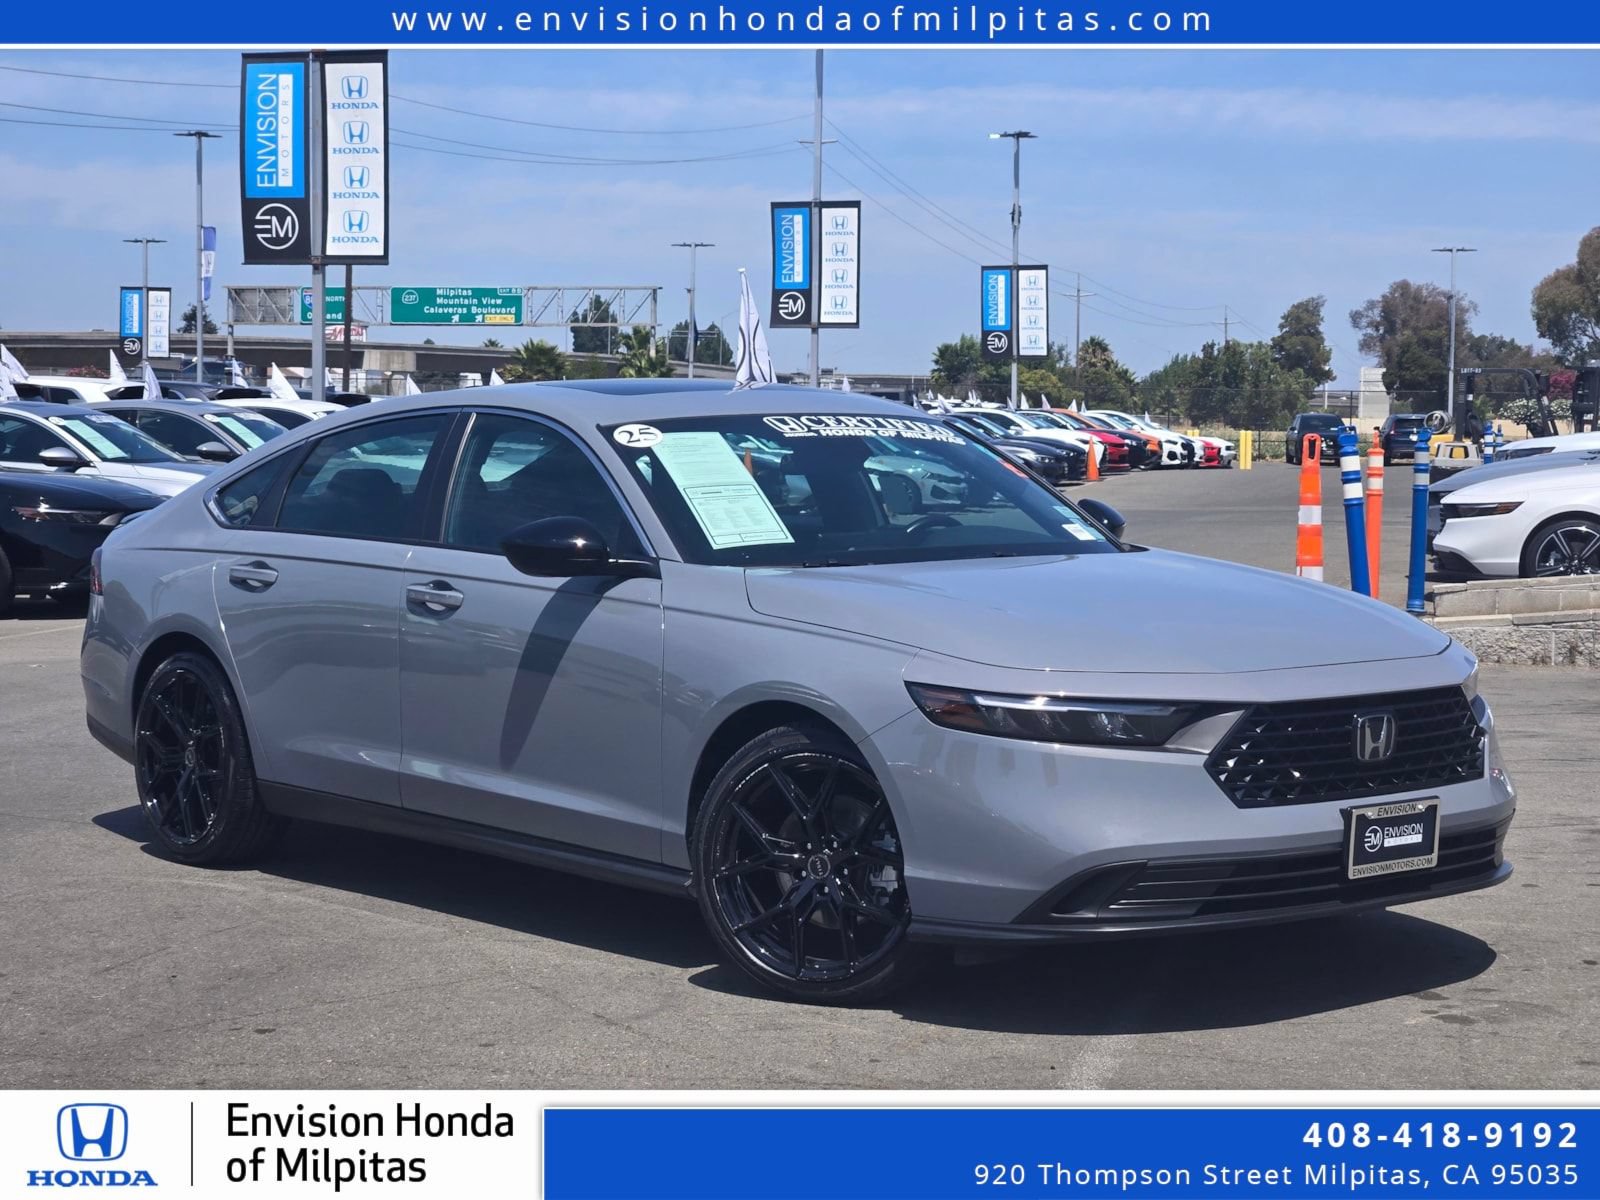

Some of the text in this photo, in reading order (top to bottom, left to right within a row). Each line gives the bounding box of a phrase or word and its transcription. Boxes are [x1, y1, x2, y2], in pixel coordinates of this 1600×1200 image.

[331, 102, 379, 110] HONDA
[256, 73, 277, 188] ENVISION
[281, 84, 290, 177] MOTORS
[332, 147, 380, 155] HONDA
[332, 191, 380, 199] HONDA
[331, 235, 379, 243] HONDA
[782, 214, 794, 283] ENVISION
[436, 288, 472, 296] Milpitas
[988, 274, 998, 326] ENVISION
[436, 297, 503, 305] Mountain View
[424, 305, 516, 314] Calaveras Boulevard
[800, 415, 954, 437] CERTIFIED
[618, 427, 658, 444] 25
[820, 429, 877, 437] HONDA
[901, 431, 967, 446] MILPITAS
[1377, 803, 1417, 817] ENVISION
[1384, 823, 1424, 839] ENVISION
[1352, 857, 1433, 877] ENVISIONMOTORS.COM
